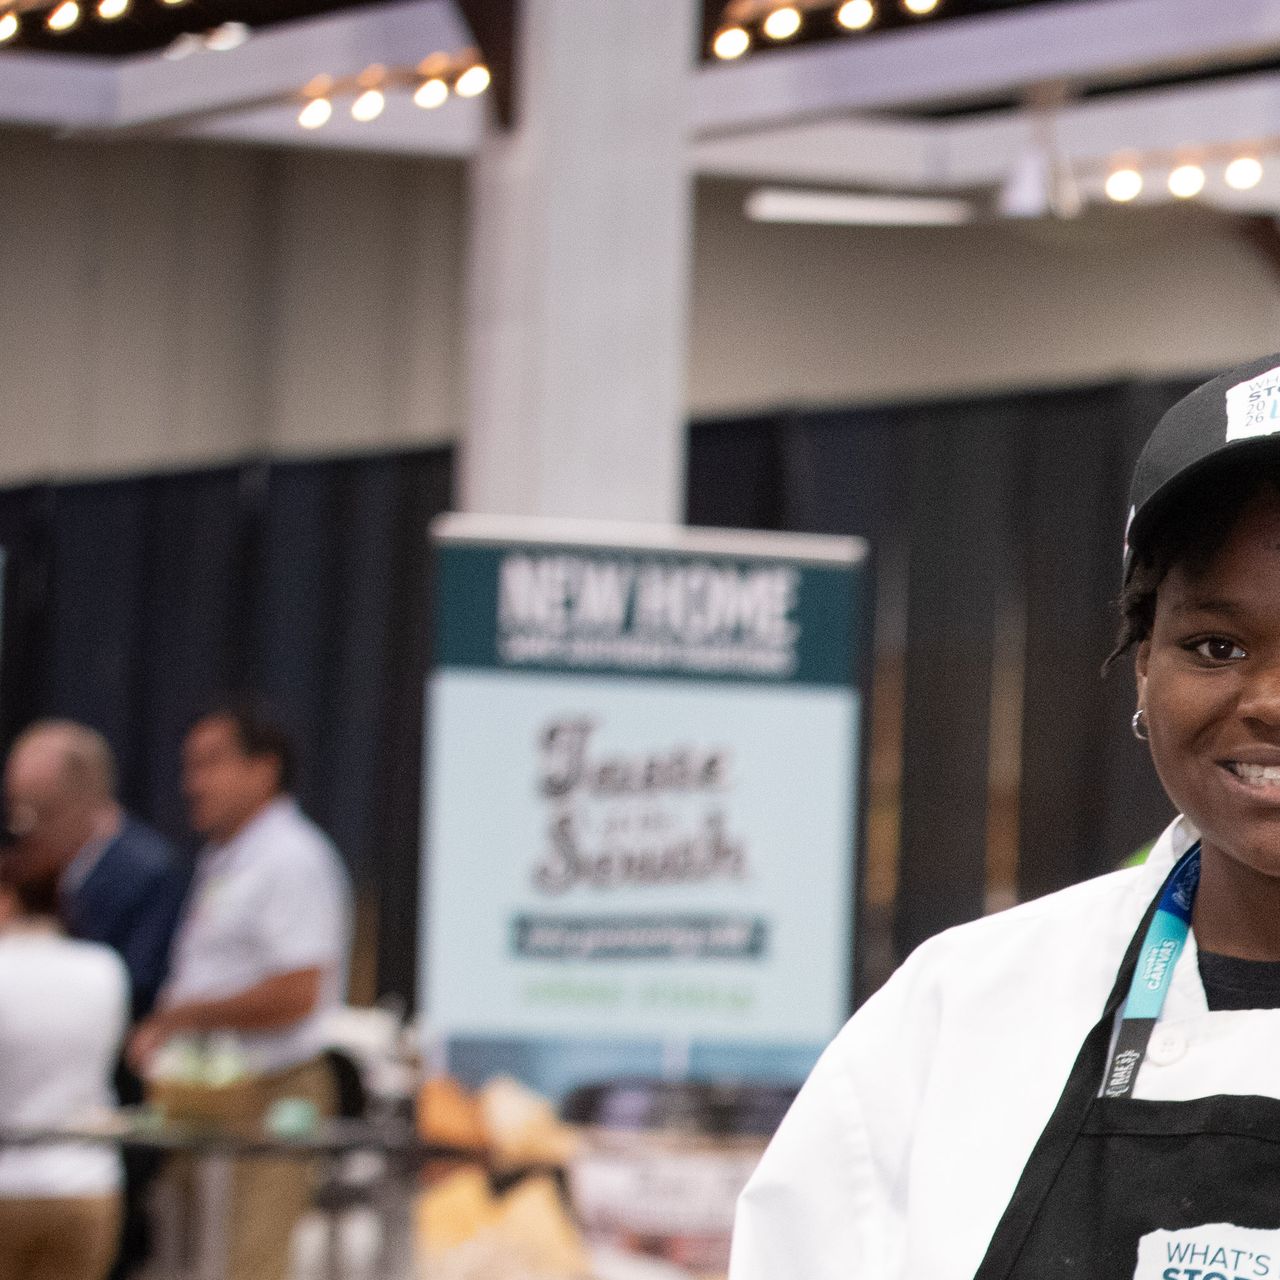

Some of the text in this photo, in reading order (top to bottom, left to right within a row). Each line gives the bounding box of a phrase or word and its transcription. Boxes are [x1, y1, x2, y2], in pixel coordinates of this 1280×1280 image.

[1245, 412, 1264, 427] 26
[1248, 400, 1266, 415] 20
[1147, 940, 1176, 990] CANVAS
[1166, 1242, 1270, 1277] WHAT'S
